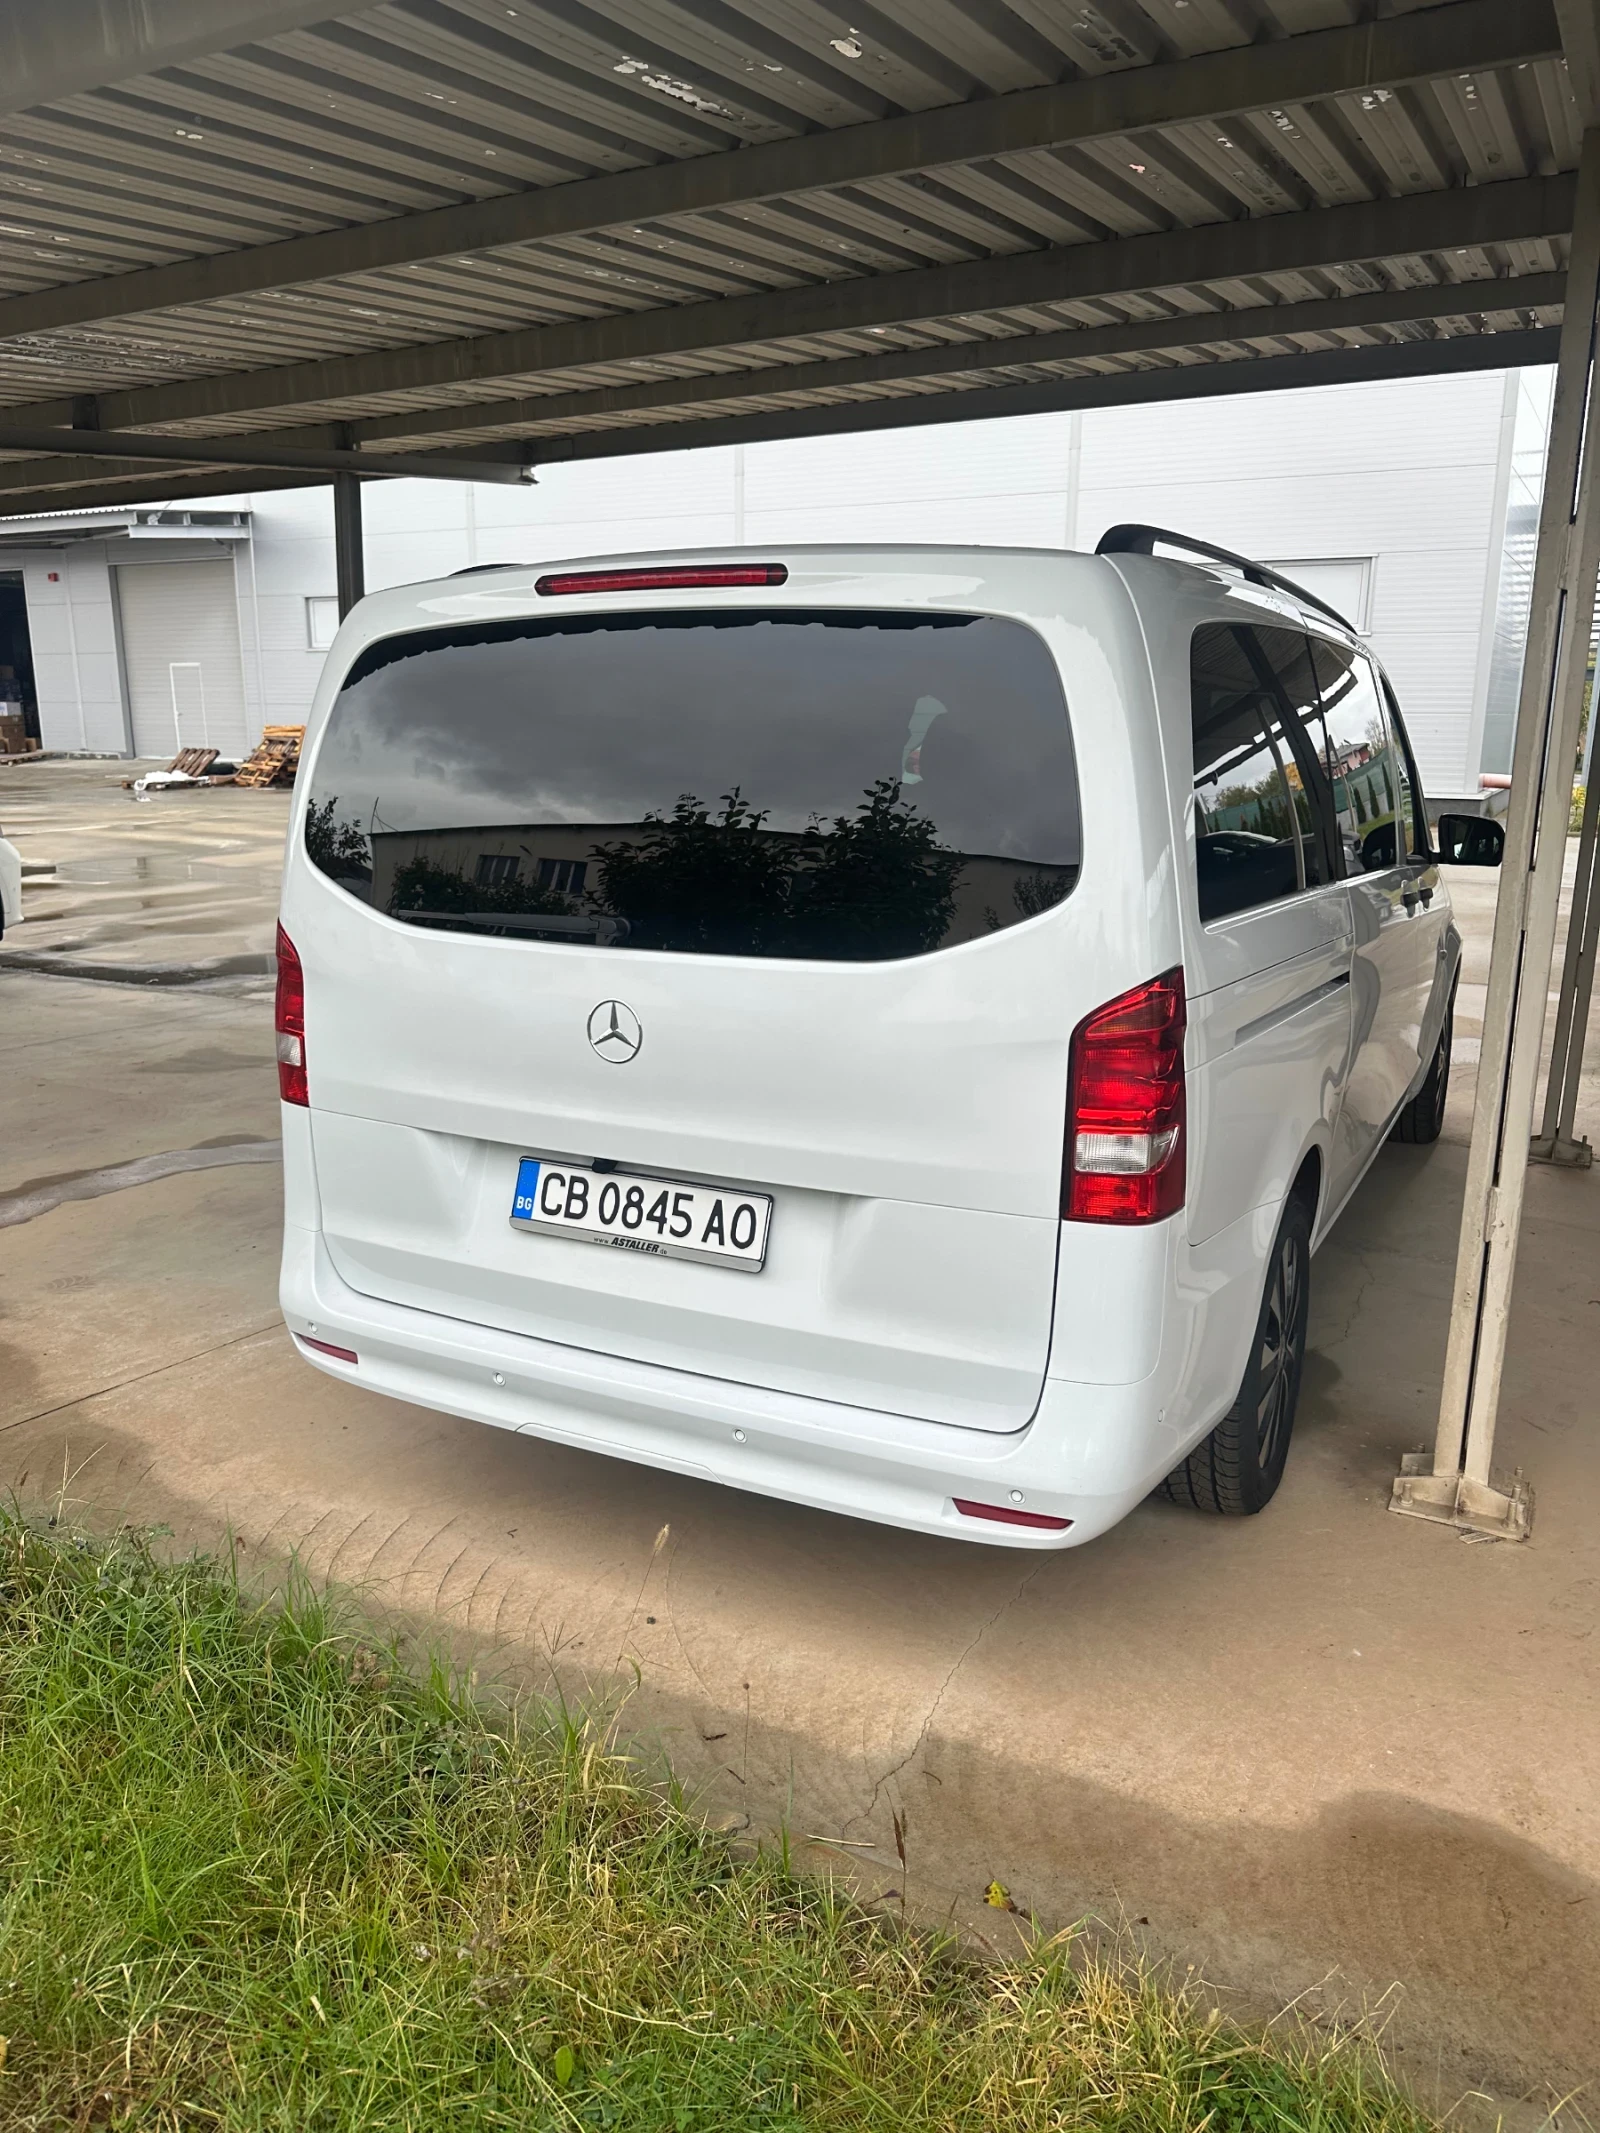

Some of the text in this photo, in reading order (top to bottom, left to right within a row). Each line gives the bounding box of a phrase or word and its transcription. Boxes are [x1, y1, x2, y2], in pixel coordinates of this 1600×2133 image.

[516, 1196, 532, 1210] BG
[540, 1172, 757, 1250] CB 0845 AO
[611, 1237, 660, 1253] ASTALLER
